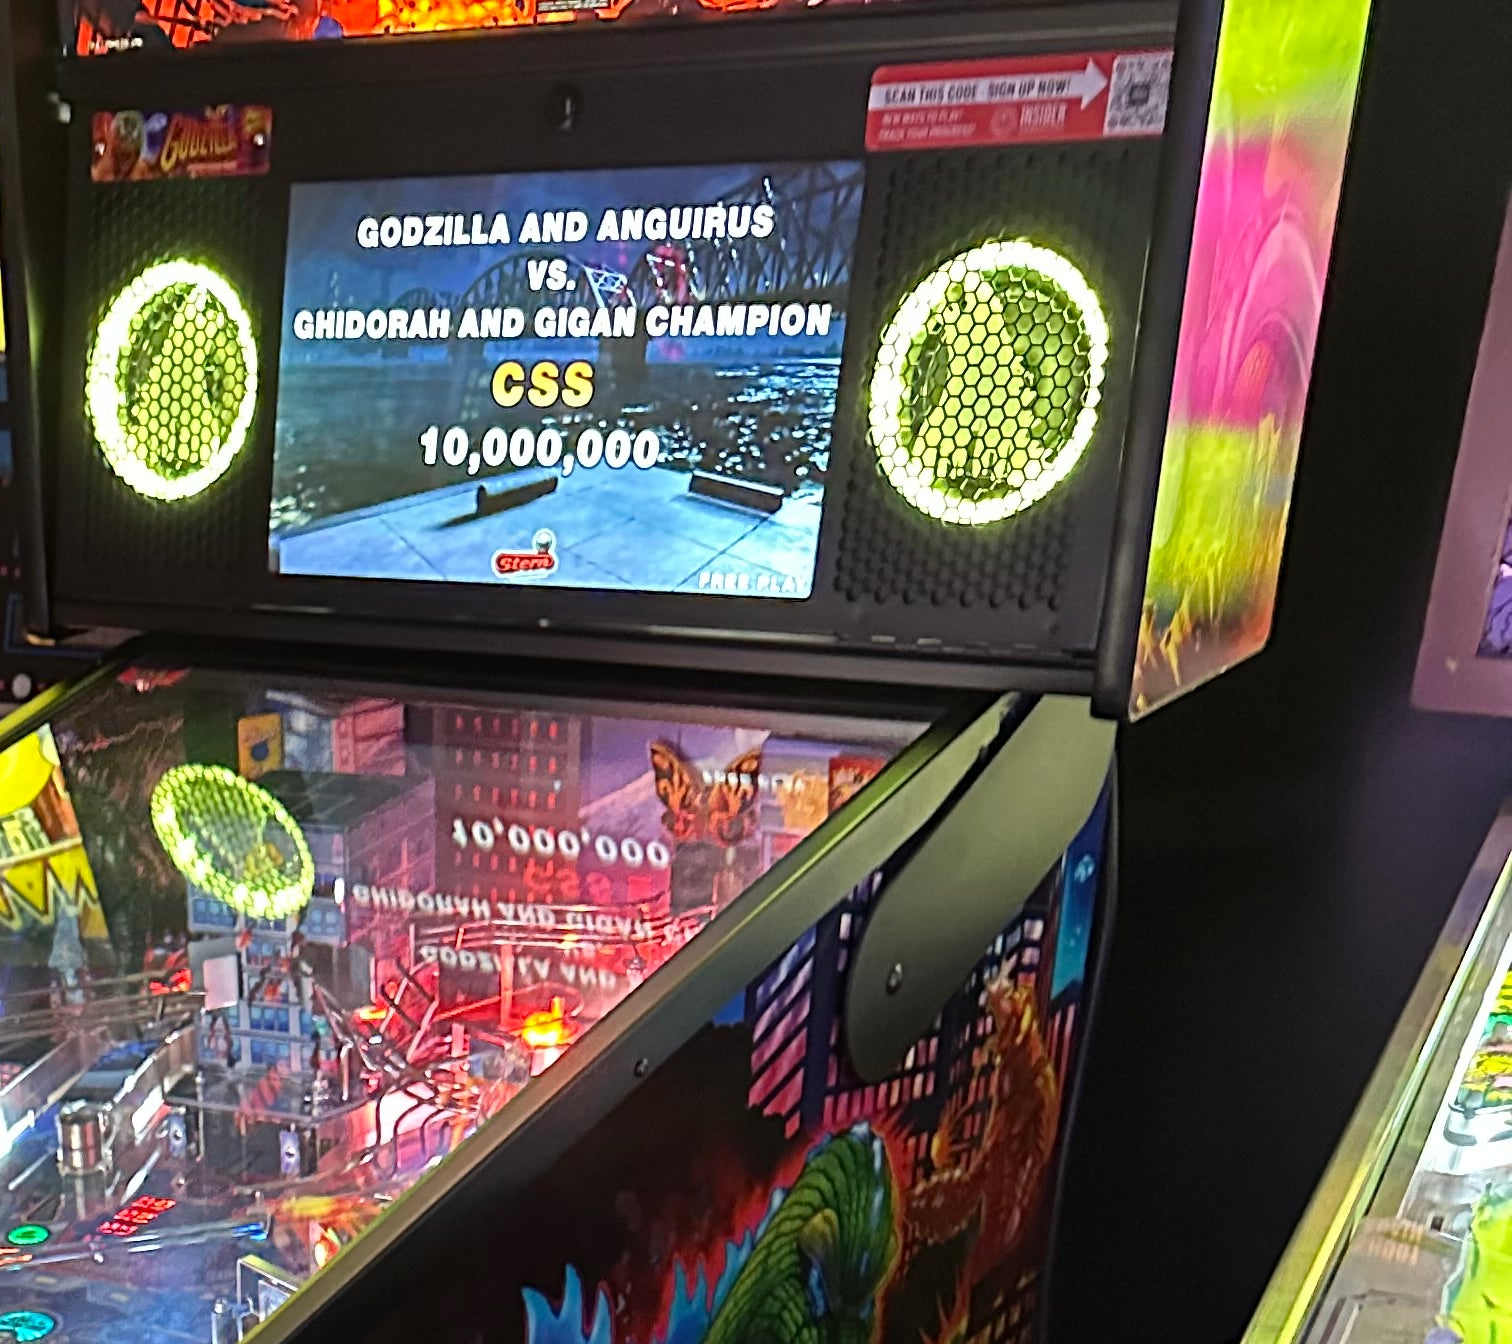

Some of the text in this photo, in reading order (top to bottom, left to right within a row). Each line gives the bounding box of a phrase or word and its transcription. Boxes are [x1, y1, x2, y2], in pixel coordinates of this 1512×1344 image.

[920, 84, 945, 102] THIS
[947, 82, 978, 101] CODE
[987, 80, 1016, 98] SIGN
[1018, 79, 1035, 96] UP
[356, 203, 775, 248] GODZILLA AND ANGUIRUS
[527, 259, 576, 292] VS.
[294, 303, 831, 340] GHIDORAH AND GIGAN CHAMPION
[491, 361, 594, 408] CSS
[419, 425, 660, 477] 10,000,000
[498, 556, 551, 572] Stern
[698, 571, 750, 590] FREE
